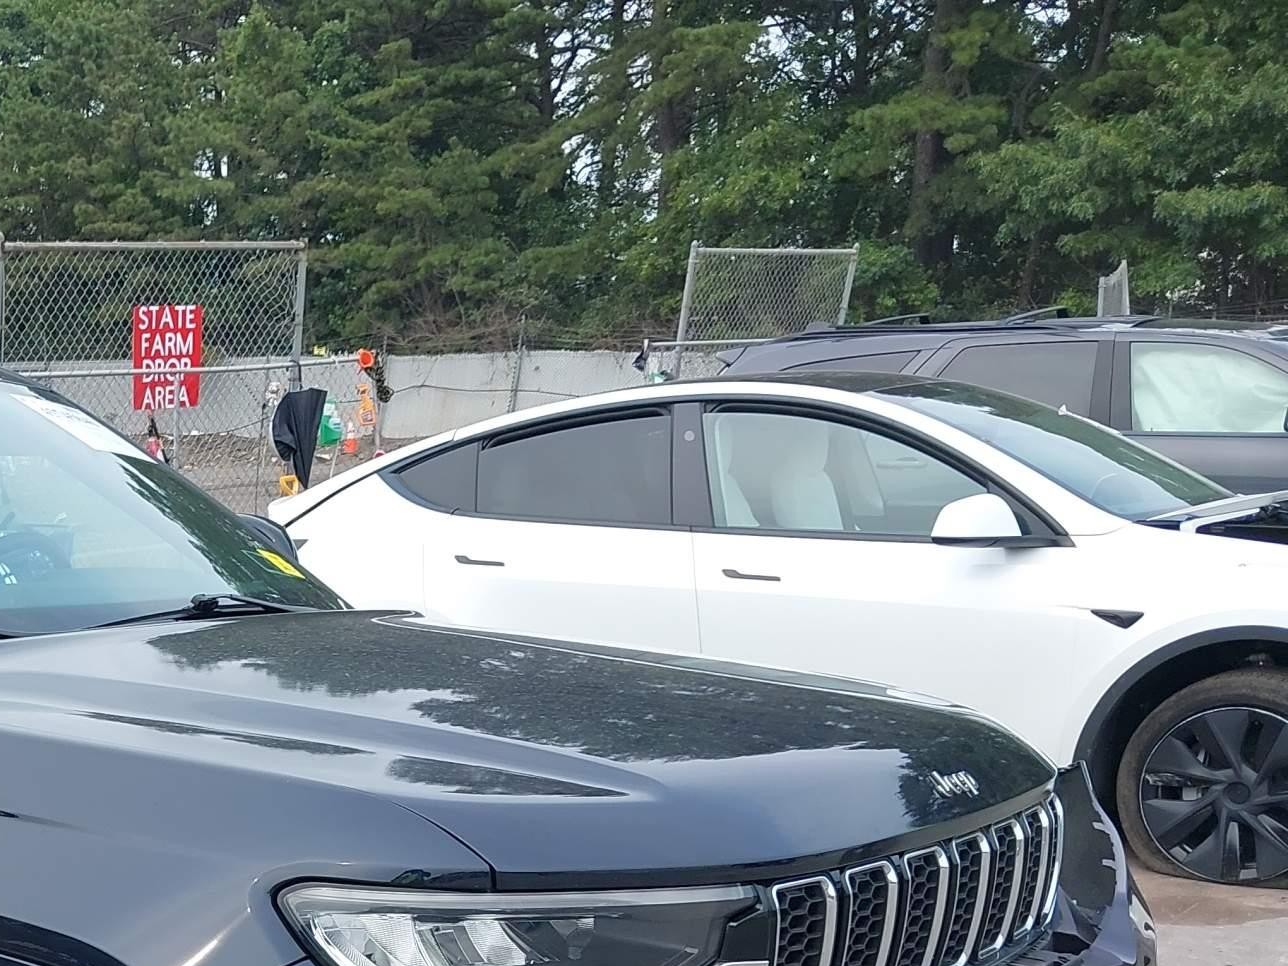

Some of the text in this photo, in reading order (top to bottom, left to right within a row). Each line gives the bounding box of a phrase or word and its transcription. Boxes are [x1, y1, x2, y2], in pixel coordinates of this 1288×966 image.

[138, 305, 197, 330] STATE
[141, 331, 194, 358] FARM
[142, 357, 192, 383] DROP
[142, 385, 190, 410] AREA
